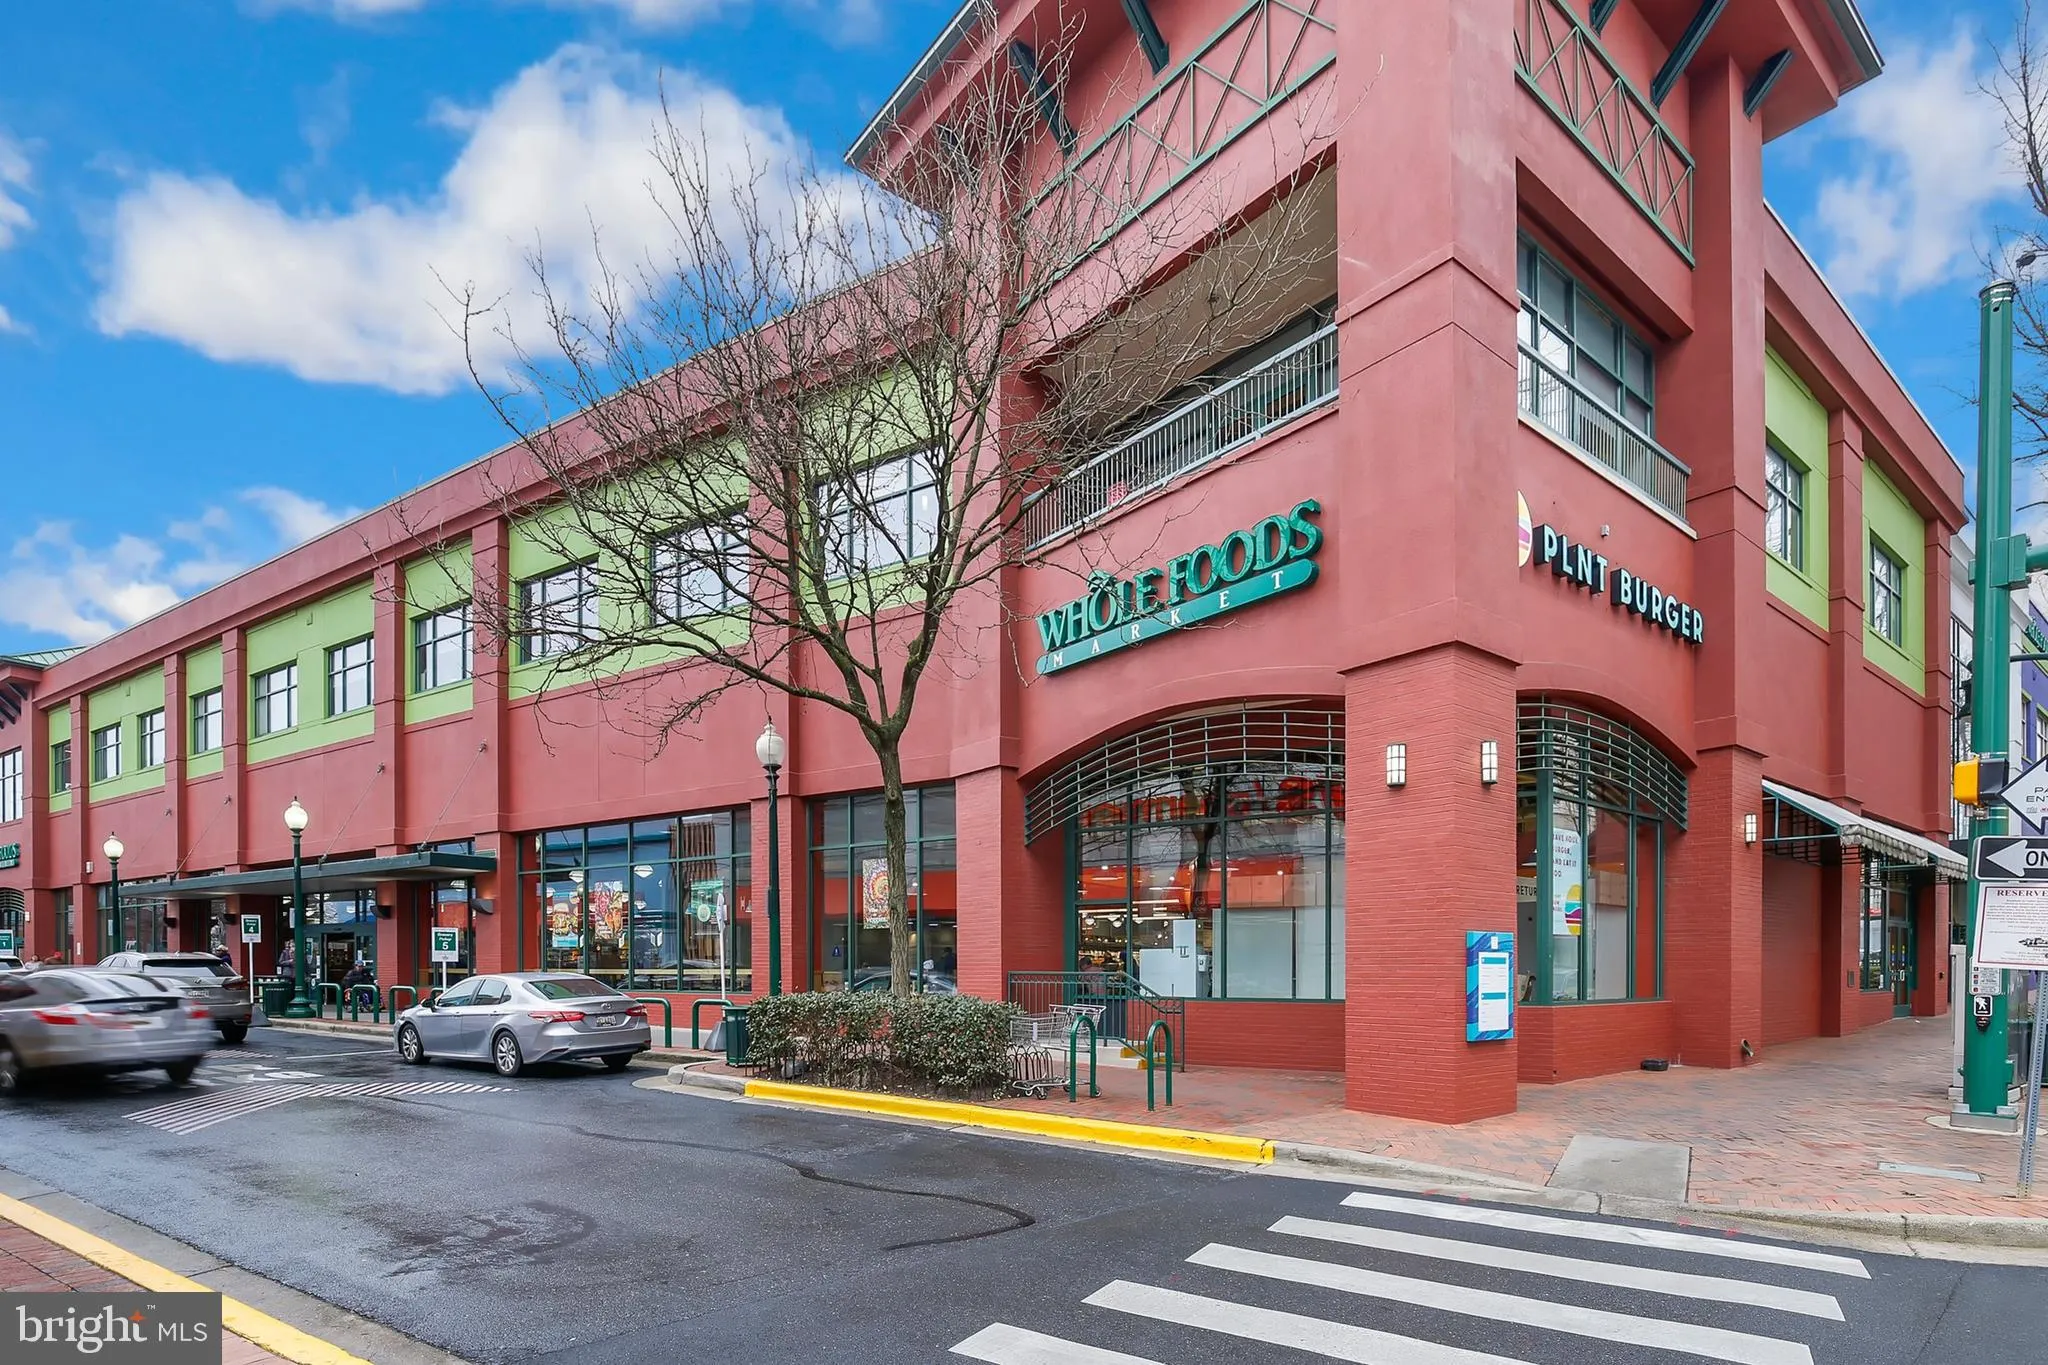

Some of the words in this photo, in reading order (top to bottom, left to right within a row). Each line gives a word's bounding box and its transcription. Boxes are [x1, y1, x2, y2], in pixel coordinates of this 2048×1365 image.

[1036, 568, 1165, 651] WHOLE
[1166, 498, 1323, 606] FOODS
[1053, 570, 1284, 668] MARKET
[1541, 524, 1608, 594] PLNT
[1616, 567, 1704, 645] BURGER
[442, 941, 449, 950] 5
